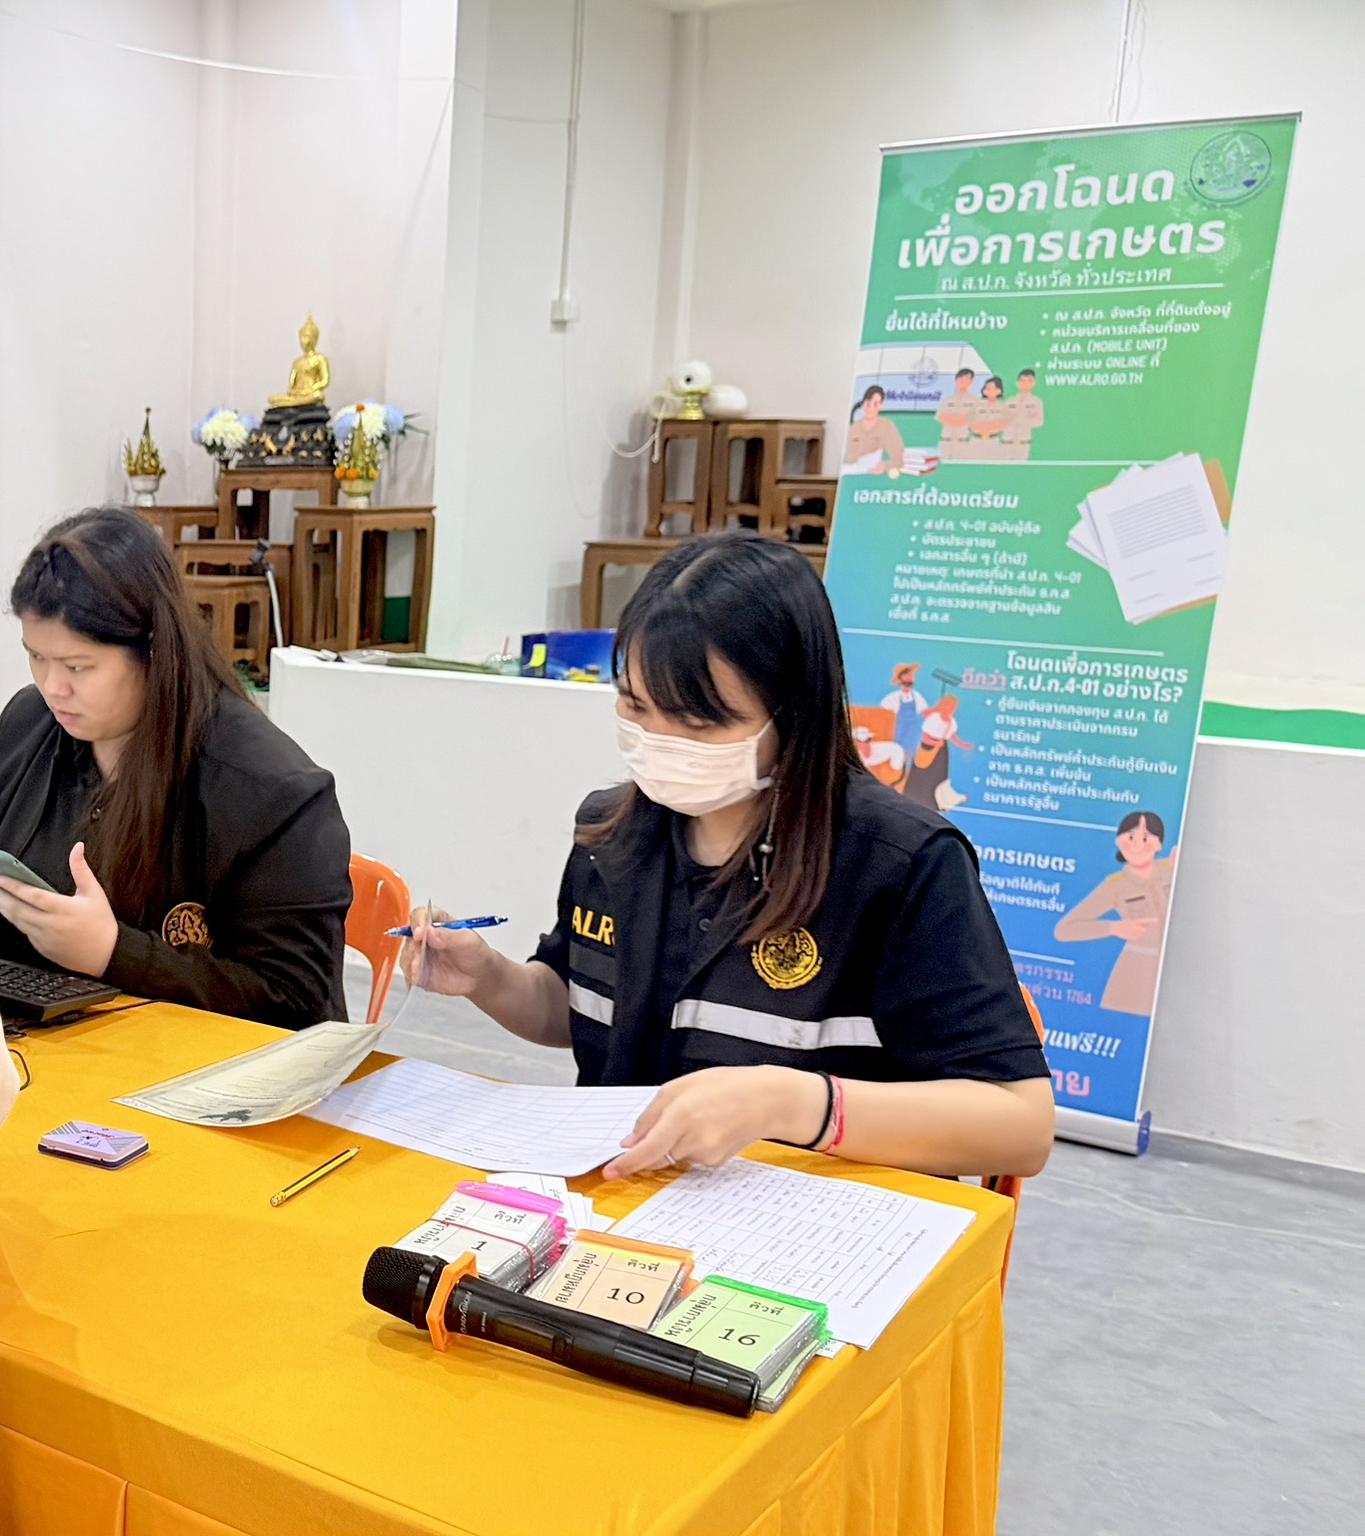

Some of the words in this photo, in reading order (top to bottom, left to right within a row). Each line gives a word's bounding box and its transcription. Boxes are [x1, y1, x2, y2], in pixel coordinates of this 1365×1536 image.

[955, 163, 1175, 215] ออกโฉนด
[898, 213, 1226, 268] เพื่อการเกษตร
[941, 277, 959, 291] ณ
[962, 274, 1010, 291] ส.ป.ก.
[1014, 268, 1071, 289] จังหวัด
[1077, 263, 1172, 287] ทั่วประเทศ
[885, 307, 1008, 332] ยื่นได้ที่ไหนบ้าง
[1111, 306, 1151, 320] จังหวัด
[1136, 338, 1167, 353] UNIT)
[1047, 355, 1102, 370] ผ่านระบบ
[1106, 355, 1146, 369] ONLINE
[853, 482, 1019, 510] เอกสารที่ต้องเตรียม
[1007, 650, 1189, 684] โฉนดเพื่อการเกษตร
[1102, 679, 1184, 703] อย่างไร?
[1154, 708, 1169, 724] ได้
[988, 761, 1011, 774] จาก
[572, 905, 616, 946] ALR
[494, 1210, 527, 1225] คิวที่
[471, 1241, 488, 1252] 1
[628, 1259, 660, 1272] คิวที่
[607, 1288, 645, 1304] 10
[749, 1301, 785, 1316] คิวที่
[718, 1328, 761, 1346] 16
